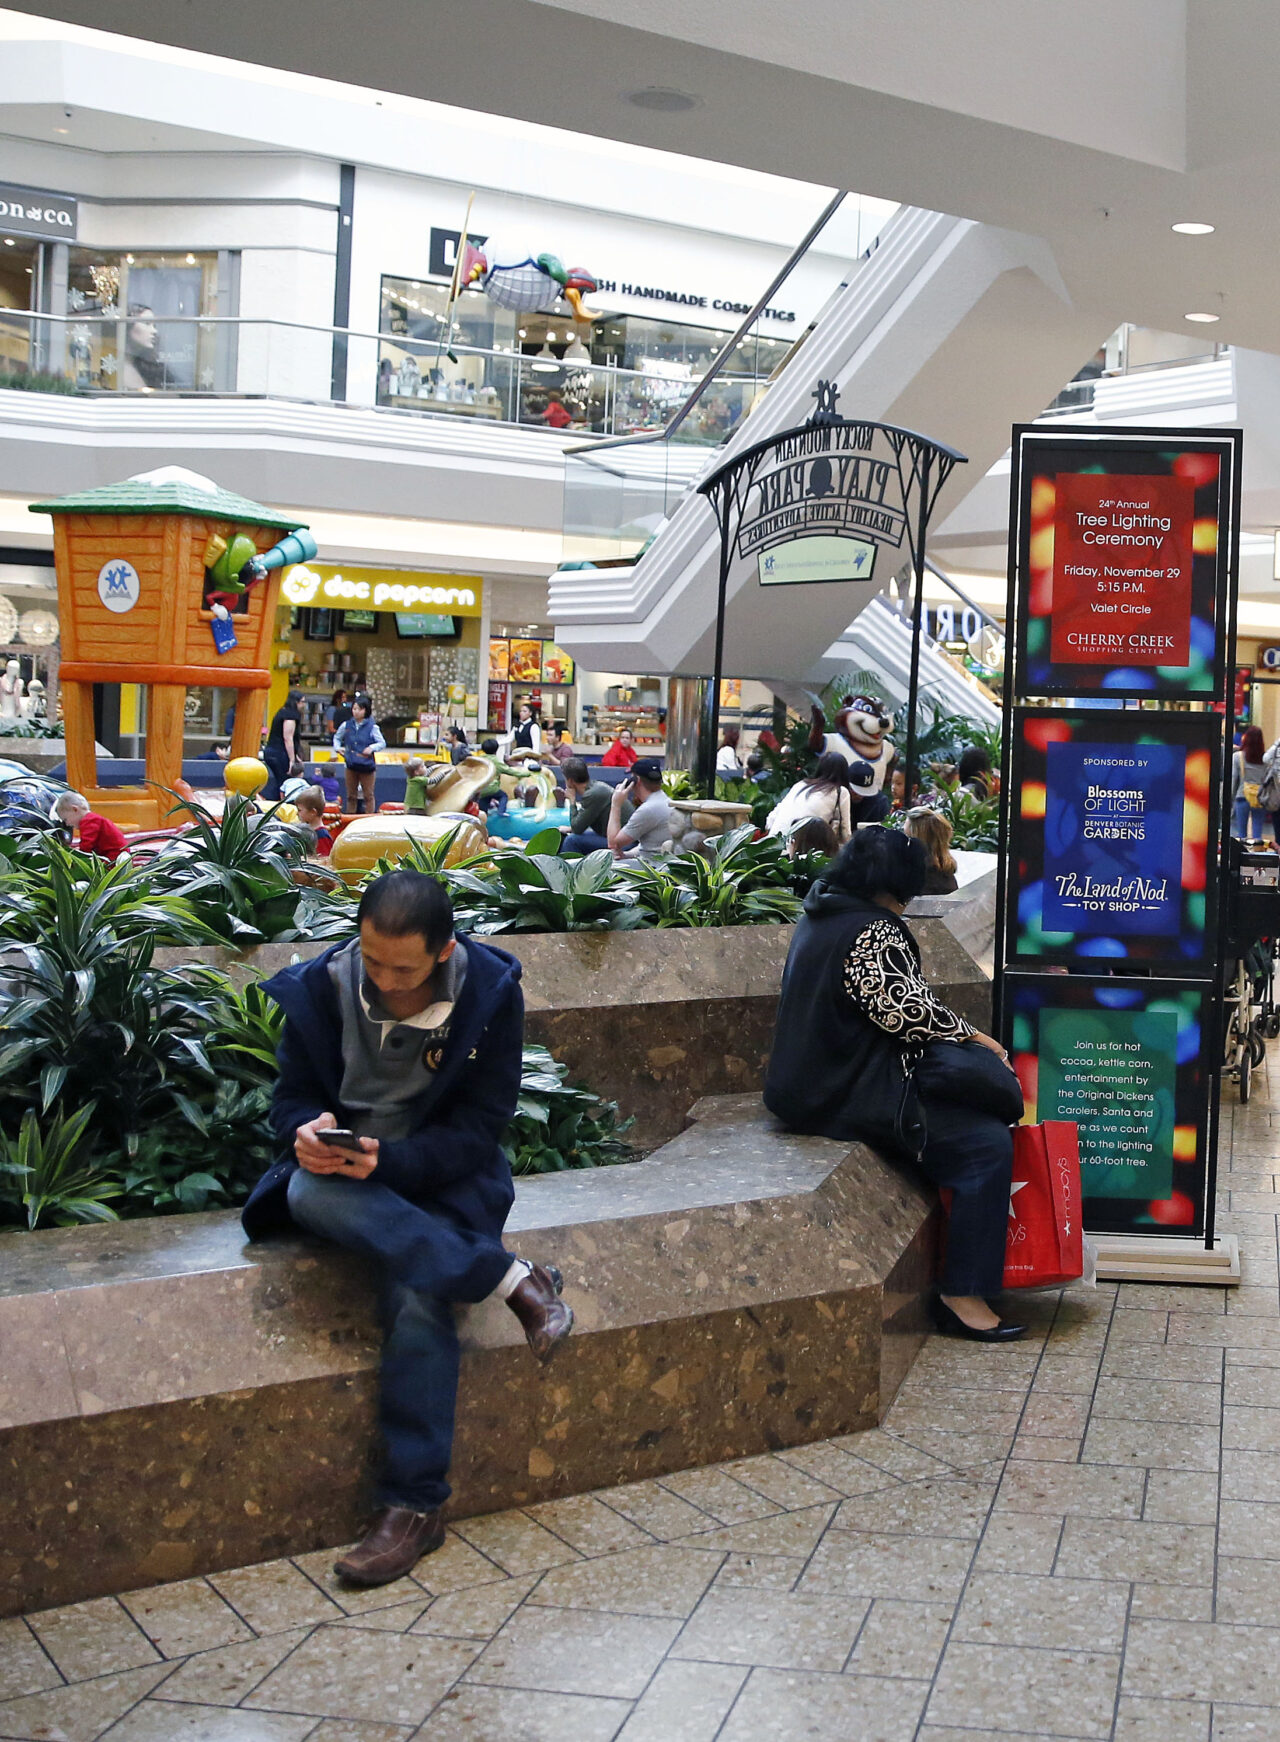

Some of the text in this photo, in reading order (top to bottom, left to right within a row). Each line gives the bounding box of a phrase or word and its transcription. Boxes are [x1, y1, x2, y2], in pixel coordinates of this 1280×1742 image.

[622, 283, 708, 308] HANDMADE
[712, 299, 796, 322] COSMTICS
[1098, 499, 1150, 510] 24th Annual
[1076, 512, 1171, 531] Tree Lighting
[1082, 531, 1164, 549] Ceremony
[1064, 564, 1181, 578] Friday, November 29
[323, 574, 476, 607] doc popcorn
[1097, 581, 1146, 593] 5:15 P.M.
[1090, 603, 1152, 614] Valet Circle
[1067, 632, 1175, 648] CHERRY CREEK
[1083, 758, 1149, 767] SPONSORED BY
[1088, 785, 1143, 799] Blossoms
[1084, 799, 1146, 812] OF LIGHT
[1085, 820, 1145, 829] DENVER BOTANIC
[1083, 827, 1145, 840] GARDENS
[1055, 872, 1083, 897] The
[1083, 876, 1122, 898] Land
[1122, 880, 1137, 901] of
[1082, 901, 1140, 912] TOY SHOP
[1073, 1040, 1141, 1051] Join us for hot
[1060, 1057, 1154, 1069] cocoa, kettle corn,
[1064, 1073, 1149, 1087] entertainment by
[1057, 1089, 1154, 1102] the Original Dickens
[1057, 1105, 1153, 1118] Carolers, Santa and
[1077, 1124, 1148, 1134] re as we count
[1086, 1140, 1096, 1149] to
[1098, 1139, 1115, 1149] the
[1117, 1140, 1153, 1152] lighting
[1089, 1155, 1124, 1166] 60-foot
[1126, 1157, 1149, 1167] tree.
